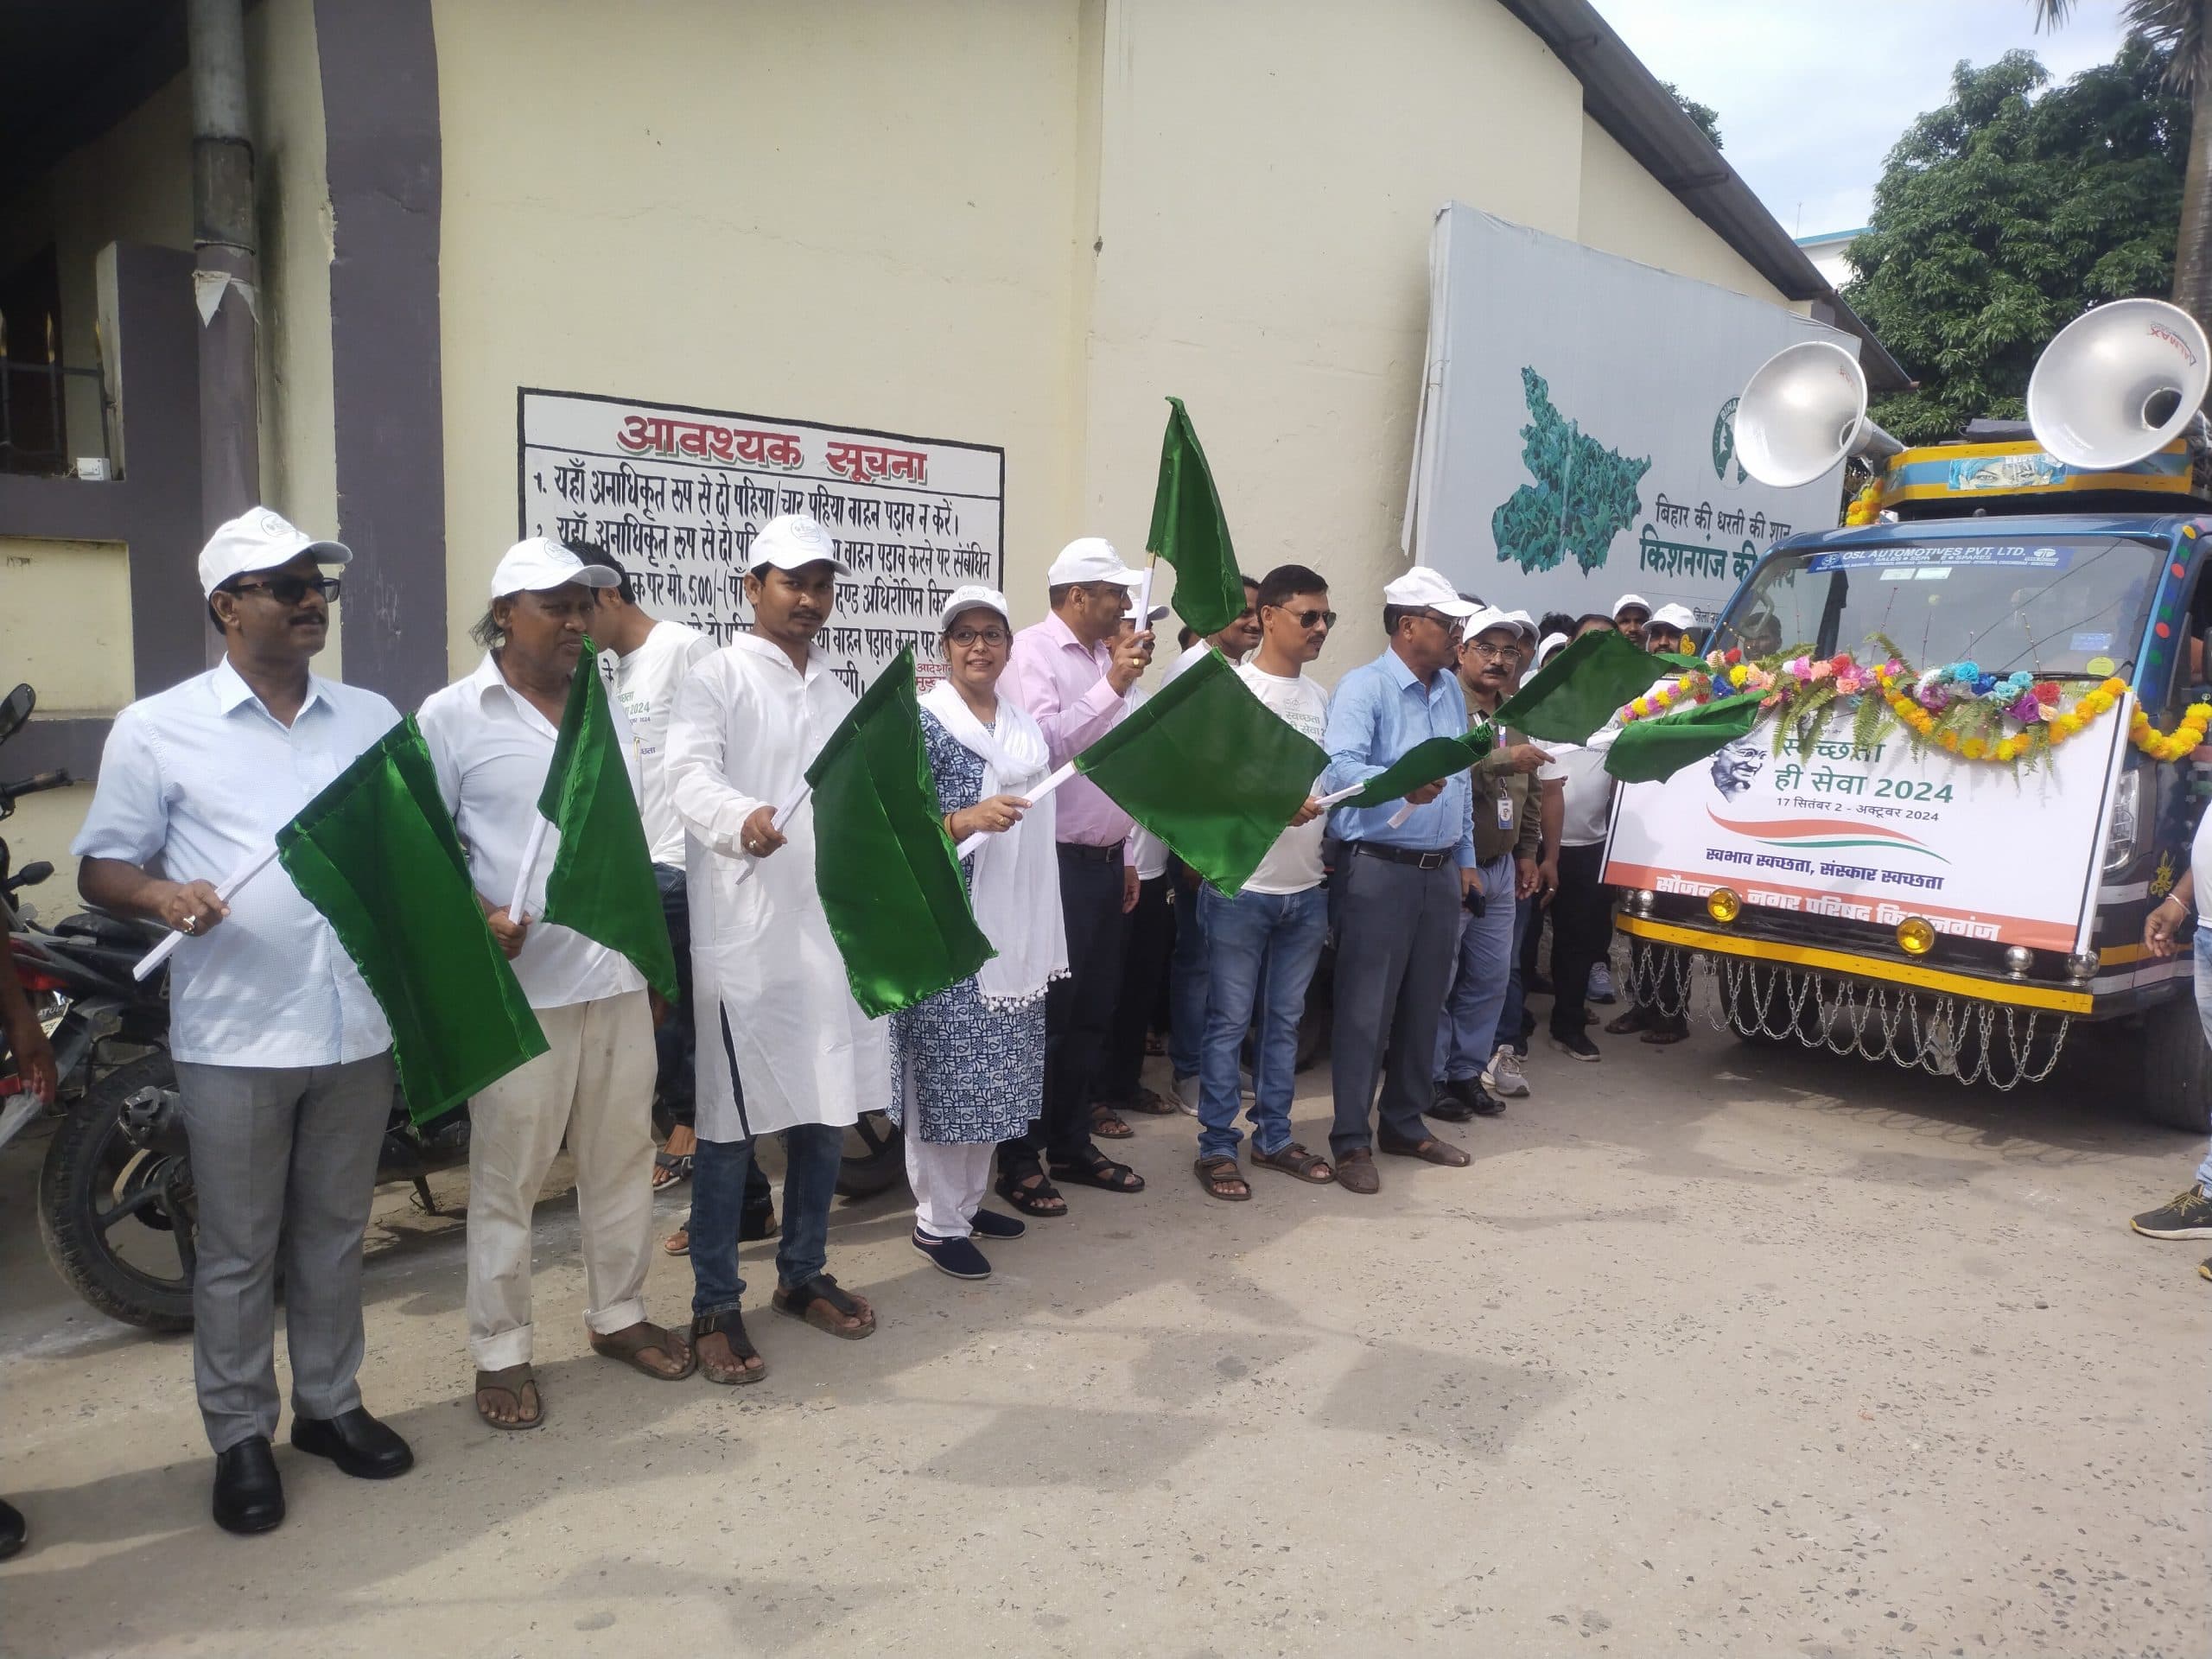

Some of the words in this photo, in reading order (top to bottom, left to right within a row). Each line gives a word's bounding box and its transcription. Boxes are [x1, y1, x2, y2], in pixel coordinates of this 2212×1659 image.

[618, 416, 802, 465] आवश्यक
[826, 442, 928, 482] सूचना
[554, 458, 586, 505] यहाँ
[671, 479, 694, 513] रूप
[698, 474, 713, 516] से
[715, 473, 731, 520] दो
[808, 484, 844, 527] पहिया
[848, 498, 880, 531] वाहन
[884, 501, 914, 537] पड़ाव
[918, 504, 930, 534] न
[1656, 493, 1690, 529] बिहार
[1694, 501, 1713, 531] की
[1718, 508, 1745, 535] धरती
[1749, 512, 1765, 539] की
[673, 525, 696, 560] रूप
[700, 519, 715, 562] से
[717, 521, 733, 566] दो
[844, 540, 874, 573] वाहन
[877, 543, 907, 578] पड़ाव
[909, 539, 934, 576] करने
[936, 549, 950, 577] पर
[952, 541, 992, 580] संबंधित
[1843, 551, 1866, 560] OSL
[1868, 547, 1962, 558] AUTOMOTIVES
[645, 572, 664, 606] पर
[862, 576, 925, 617] अधिरोपित
[832, 627, 862, 658] वाहन
[864, 629, 893, 665] पड़ाव
[920, 631, 936, 658] पर
[1775, 764, 1804, 791] ही
[1811, 766, 1868, 796] सेवा
[1874, 779, 1954, 804] 2024
[1777, 798, 1790, 806] 17
[1835, 803, 1842, 811] 2
[1905, 810, 1939, 821] 2024
[1706, 848, 1753, 865] स्वभाव
[1756, 855, 1815, 875] स्वच्छता,
[1820, 860, 1878, 881] संस्कार
[1881, 869, 1944, 890] स्वच्छता
[1747, 888, 1803, 910] नगर
[1805, 895, 1873, 921] परिषद
